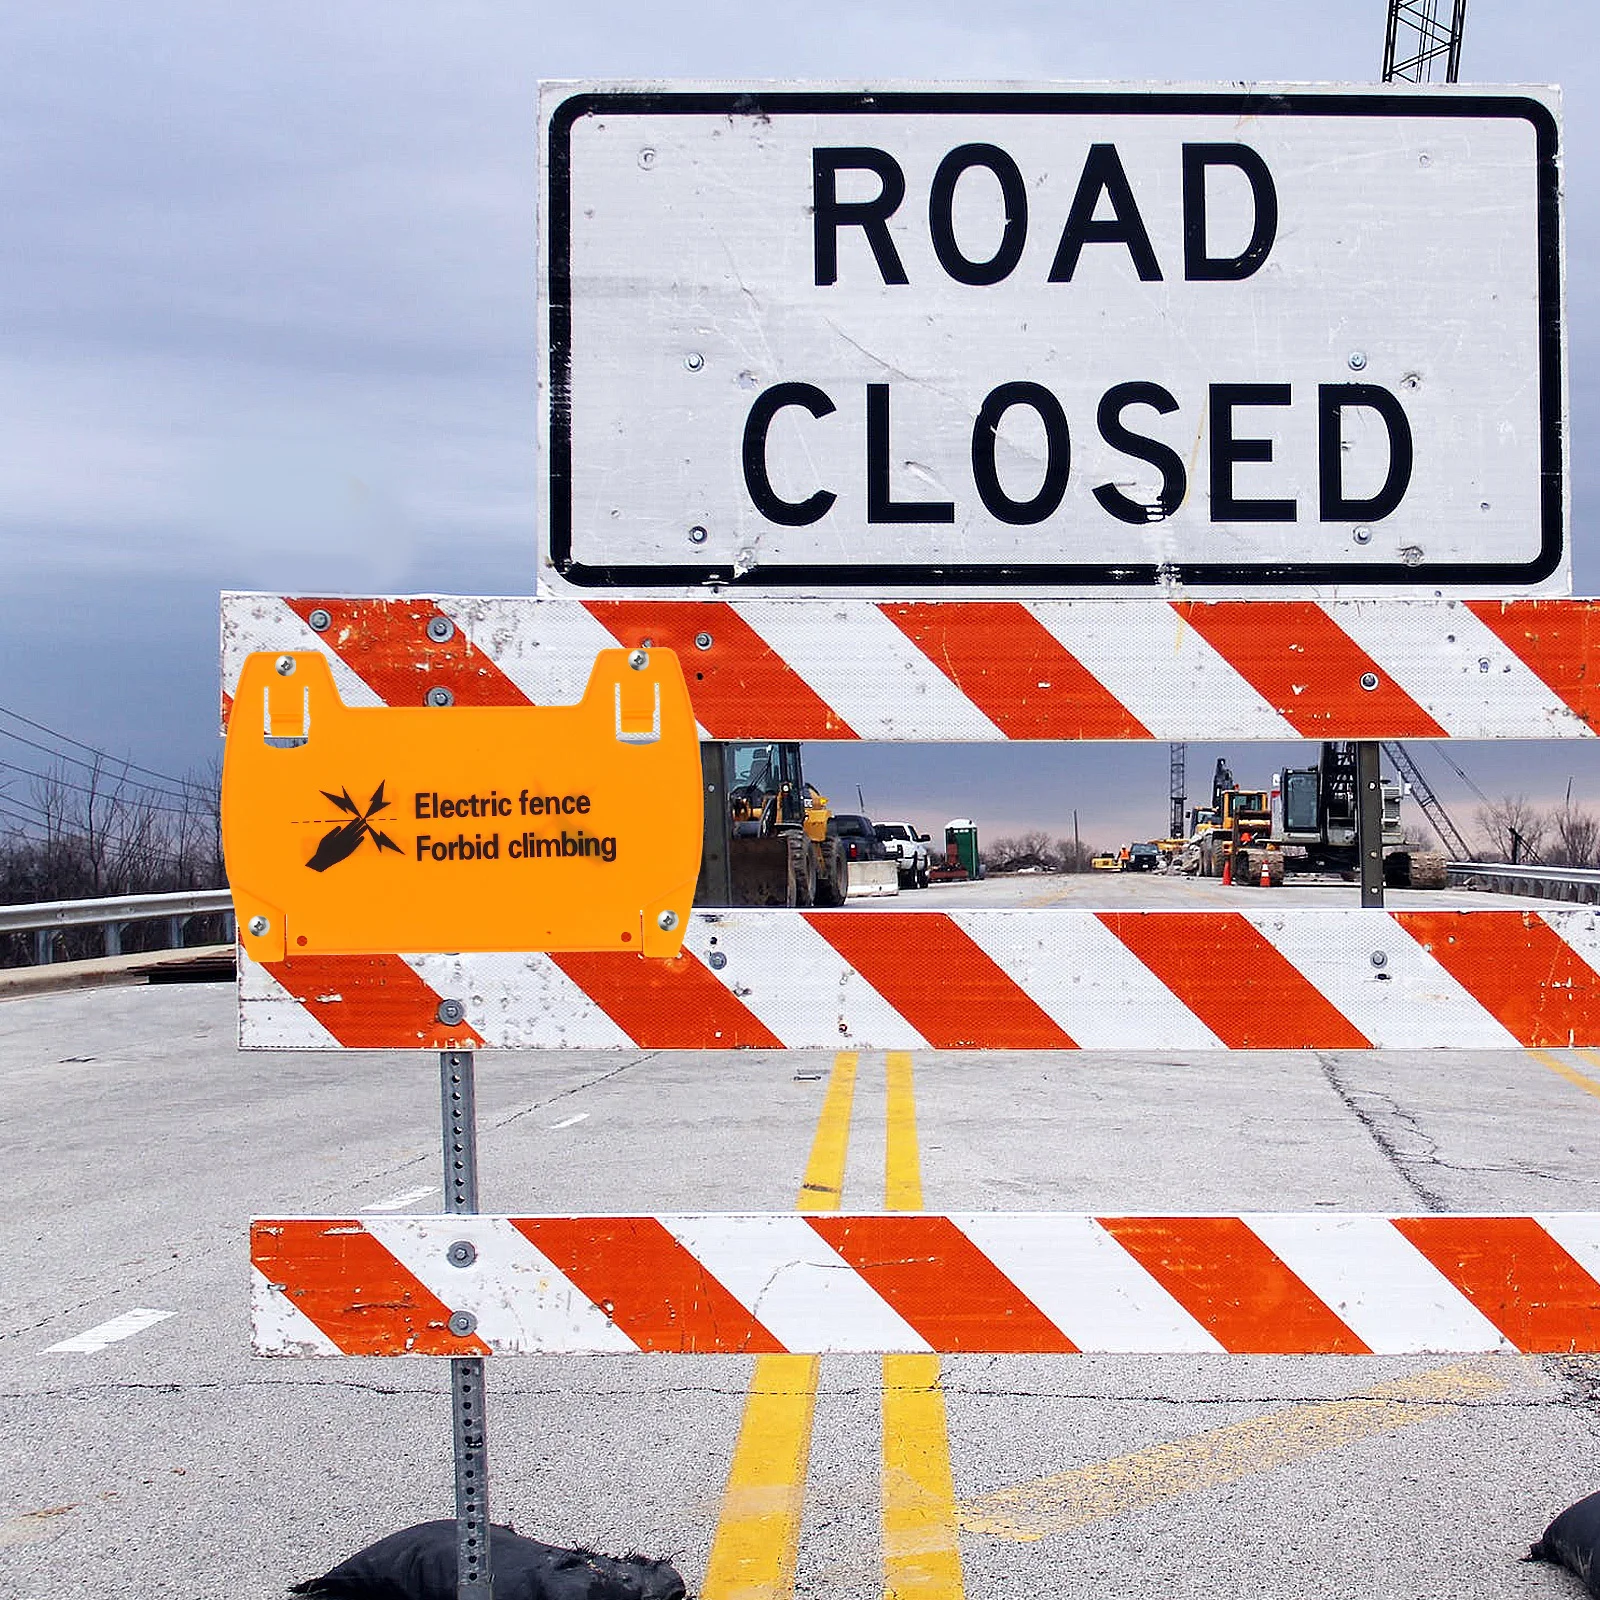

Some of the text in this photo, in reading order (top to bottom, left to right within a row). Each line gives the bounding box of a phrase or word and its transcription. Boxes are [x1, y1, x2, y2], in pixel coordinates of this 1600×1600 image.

[811, 143, 1277, 286] ROAD
[743, 381, 1413, 526] CLOSED
[414, 789, 590, 819] Electric fence
[417, 831, 616, 862] Forbid climbing
